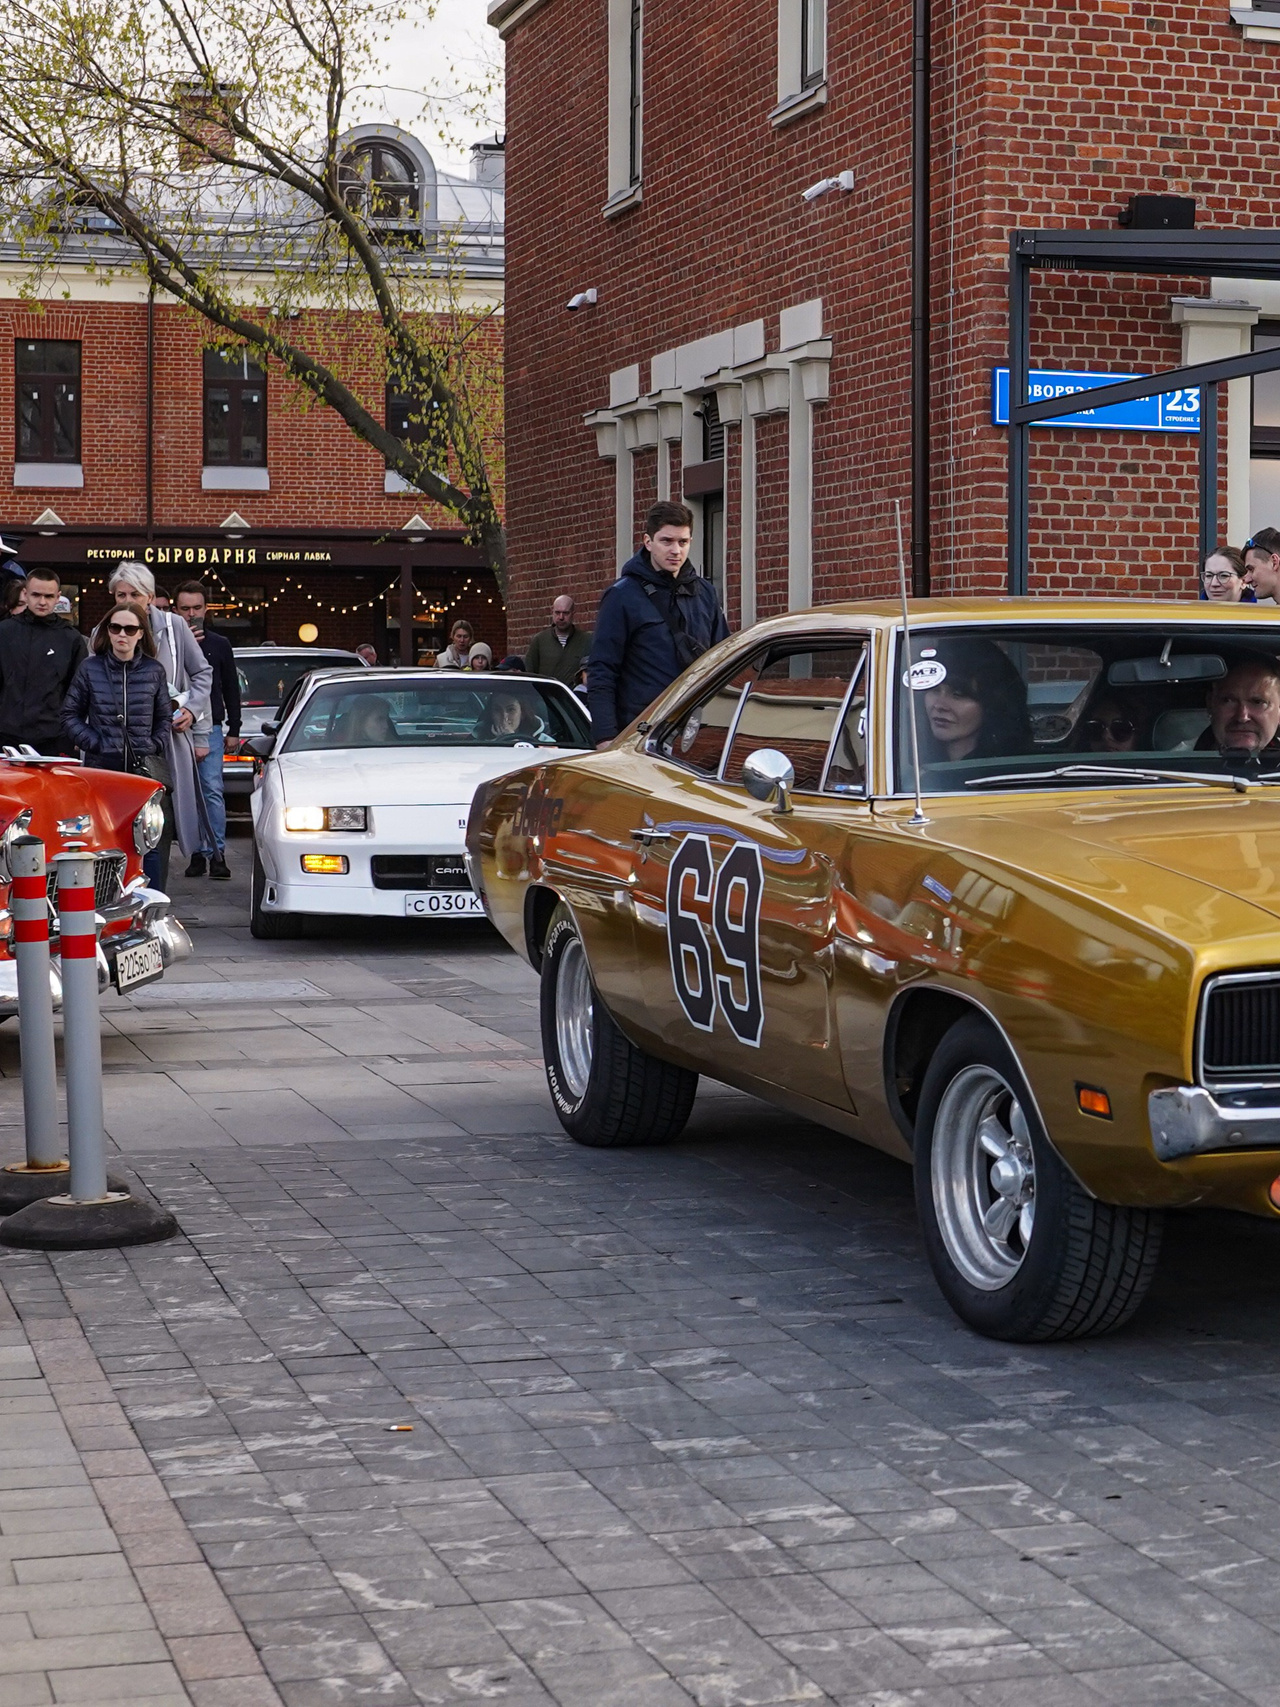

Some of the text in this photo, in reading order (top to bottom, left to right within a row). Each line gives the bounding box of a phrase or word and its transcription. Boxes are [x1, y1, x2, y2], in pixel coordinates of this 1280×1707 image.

[1165, 387, 1200, 413] 23
[87, 547, 332, 564] РЕСТОРАН СЫРОВАРНЯ СЫРНАЯ ЛАВКА
[665, 831, 765, 1049] 69
